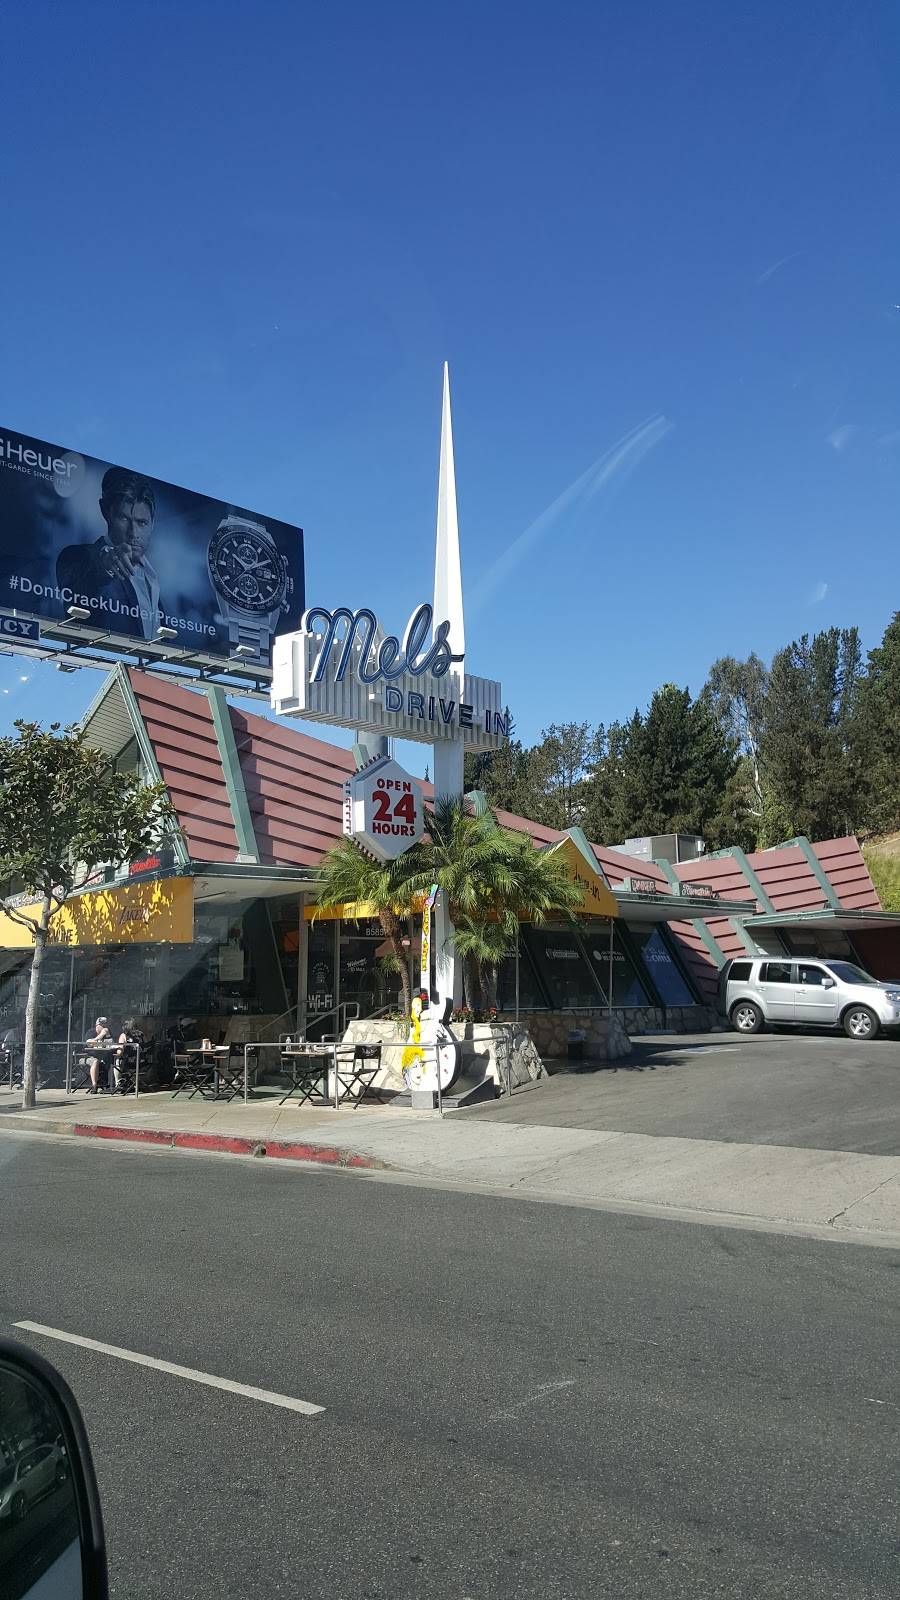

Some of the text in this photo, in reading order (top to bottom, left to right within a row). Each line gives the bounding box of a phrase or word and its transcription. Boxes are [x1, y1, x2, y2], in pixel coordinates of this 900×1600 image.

[0, 460, 55, 482] T-GARDE SINCE
[8, 574, 217, 637] #DontCrackUnderPressure
[0, 617, 33, 637] CY
[302, 603, 465, 684] Mels
[385, 685, 510, 738] DRIVE IN
[375, 777, 412, 793] OPEN
[371, 790, 417, 825] 24
[371, 822, 416, 838] HOURS
[308, 994, 333, 1009] Wi-Fi
